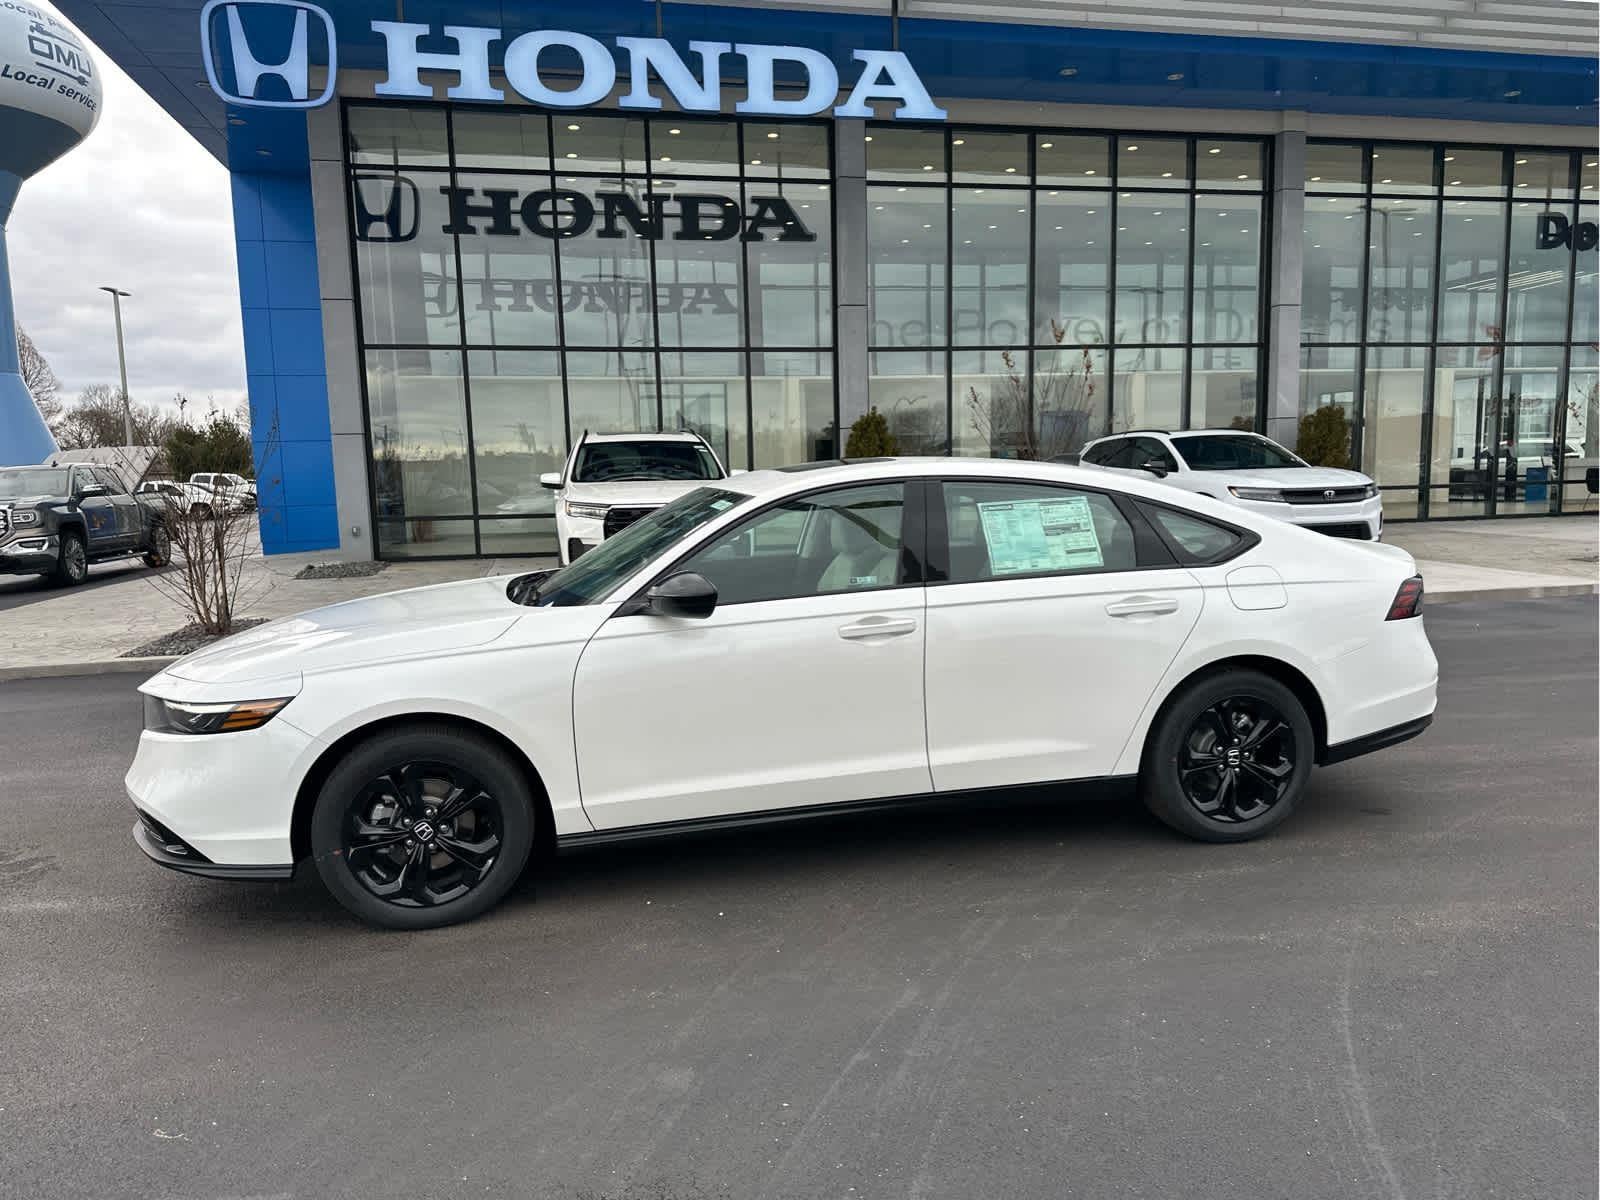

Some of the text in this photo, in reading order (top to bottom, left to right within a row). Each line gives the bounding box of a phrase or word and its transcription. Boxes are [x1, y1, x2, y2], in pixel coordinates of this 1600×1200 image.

[0, 0, 43, 20] ocal
[1, 64, 97, 112] Local service
[372, 20, 947, 120] HONDA
[439, 186, 817, 242] HONDA
